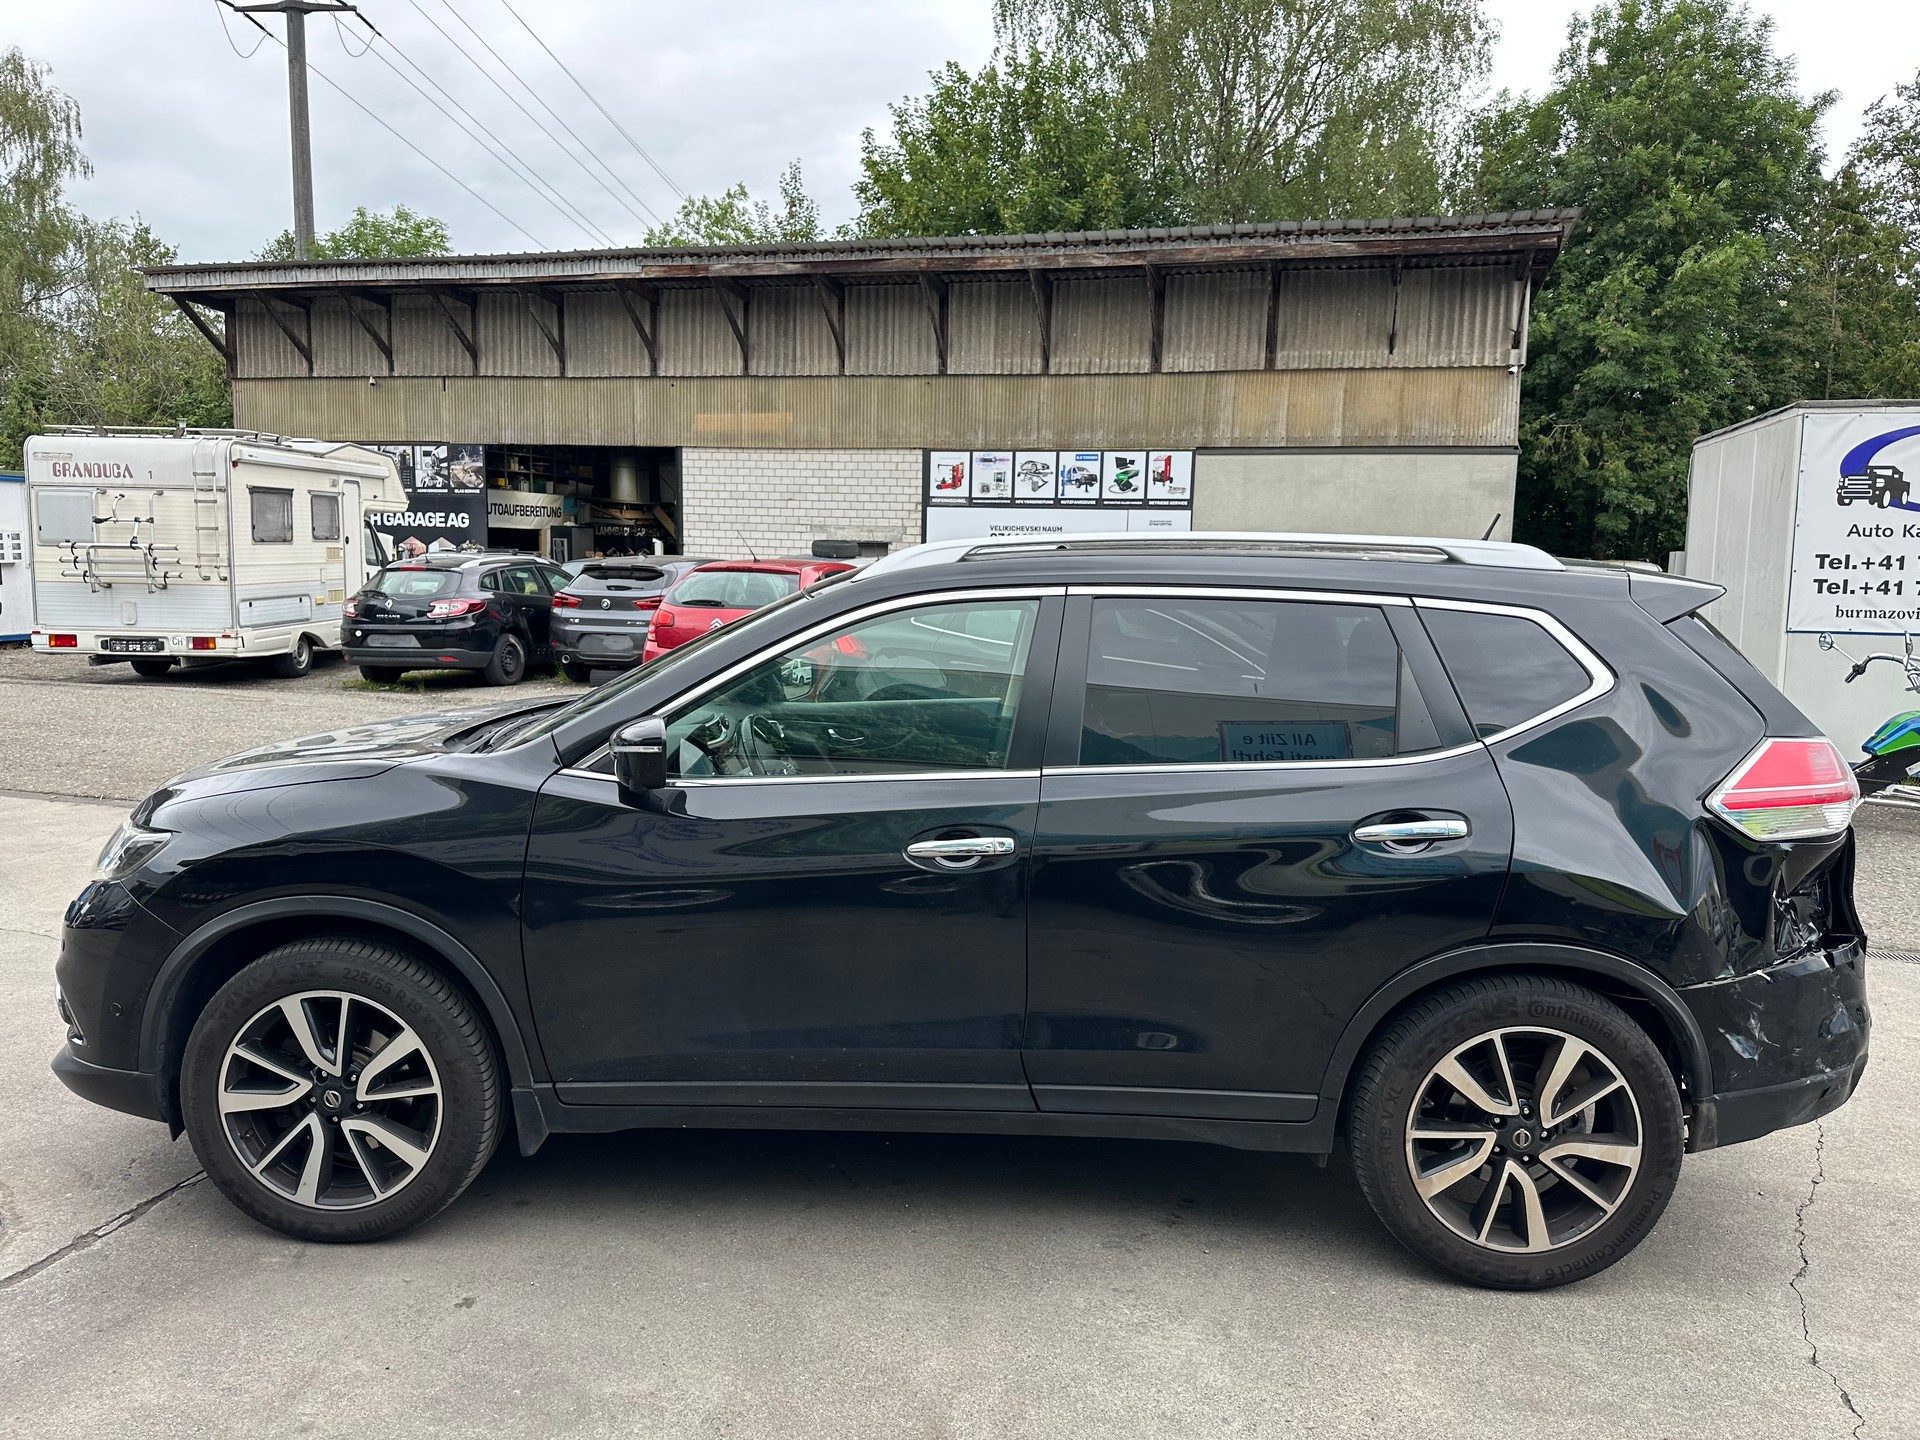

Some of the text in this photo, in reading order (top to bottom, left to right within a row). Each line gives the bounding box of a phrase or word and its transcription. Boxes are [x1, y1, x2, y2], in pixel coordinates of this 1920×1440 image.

[52, 461, 134, 479] GRANDUCA
[382, 511, 445, 528] GARAGE
[446, 512, 470, 528] AG
[1846, 523, 1894, 538] Auto
[171, 636, 184, 646] CH
[1526, 1000, 1622, 1041] Continental
